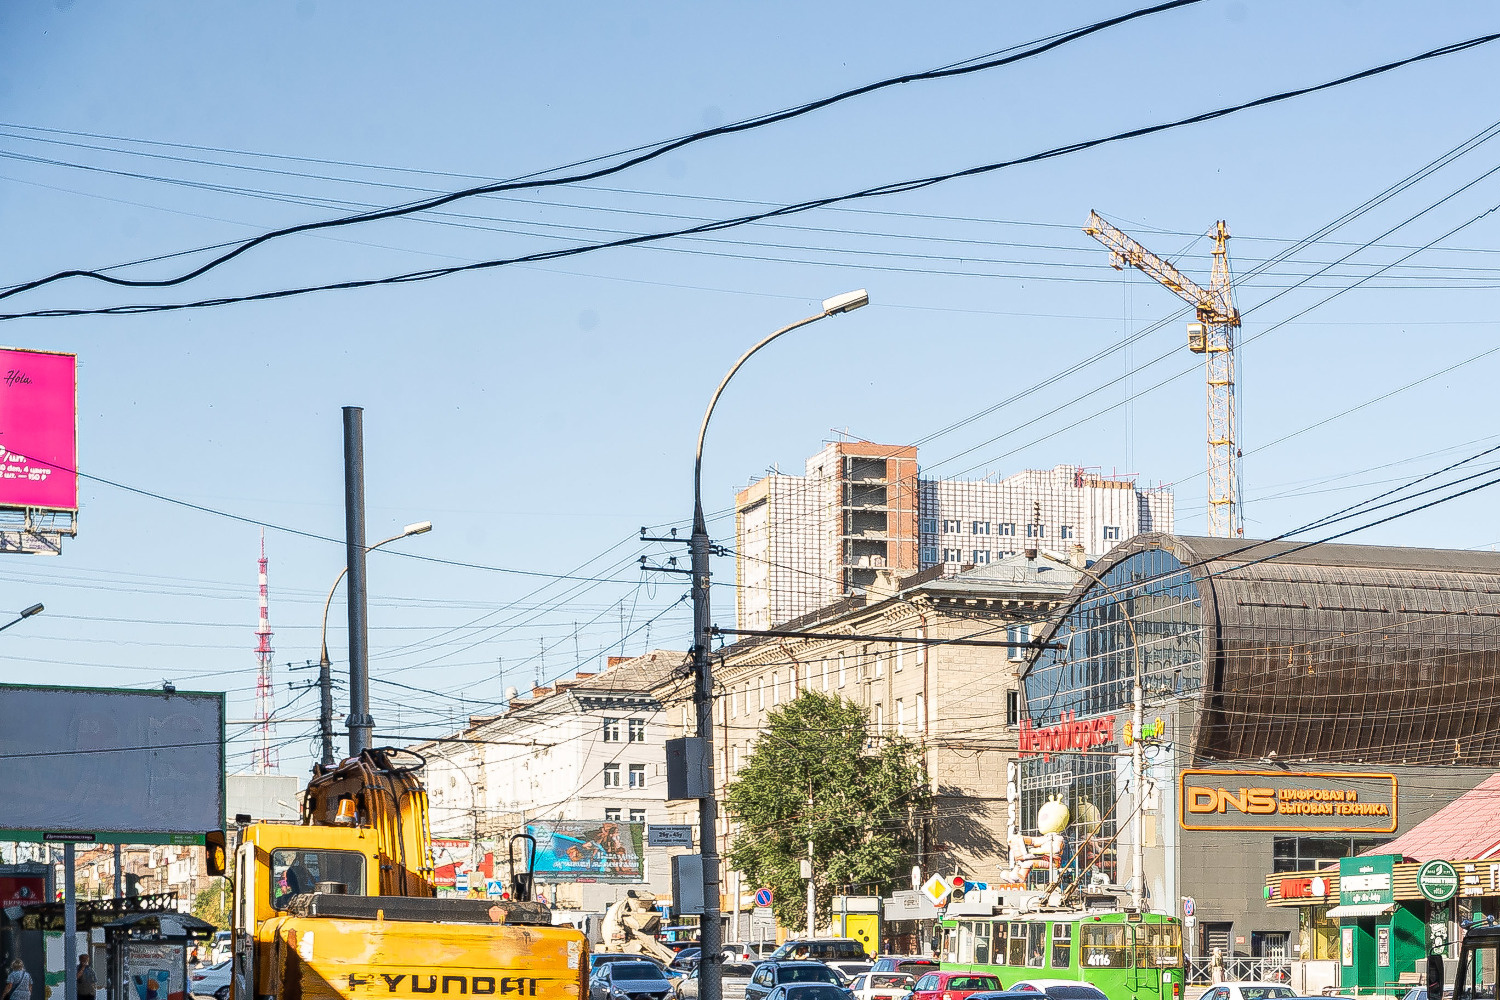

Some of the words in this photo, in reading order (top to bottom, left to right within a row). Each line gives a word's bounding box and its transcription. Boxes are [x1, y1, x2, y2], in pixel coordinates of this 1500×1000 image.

[1188, 787, 1277, 814] DNS
[1278, 788, 1344, 802] ЦИФРОВАЯ
[1346, 789, 1357, 801] И
[1278, 801, 1333, 815] БЫТОВАЯ
[1336, 802, 1389, 816] ТЕХНИКА
[1088, 954, 1110, 966] 4116
[349, 973, 537, 996] HYUNDAI
